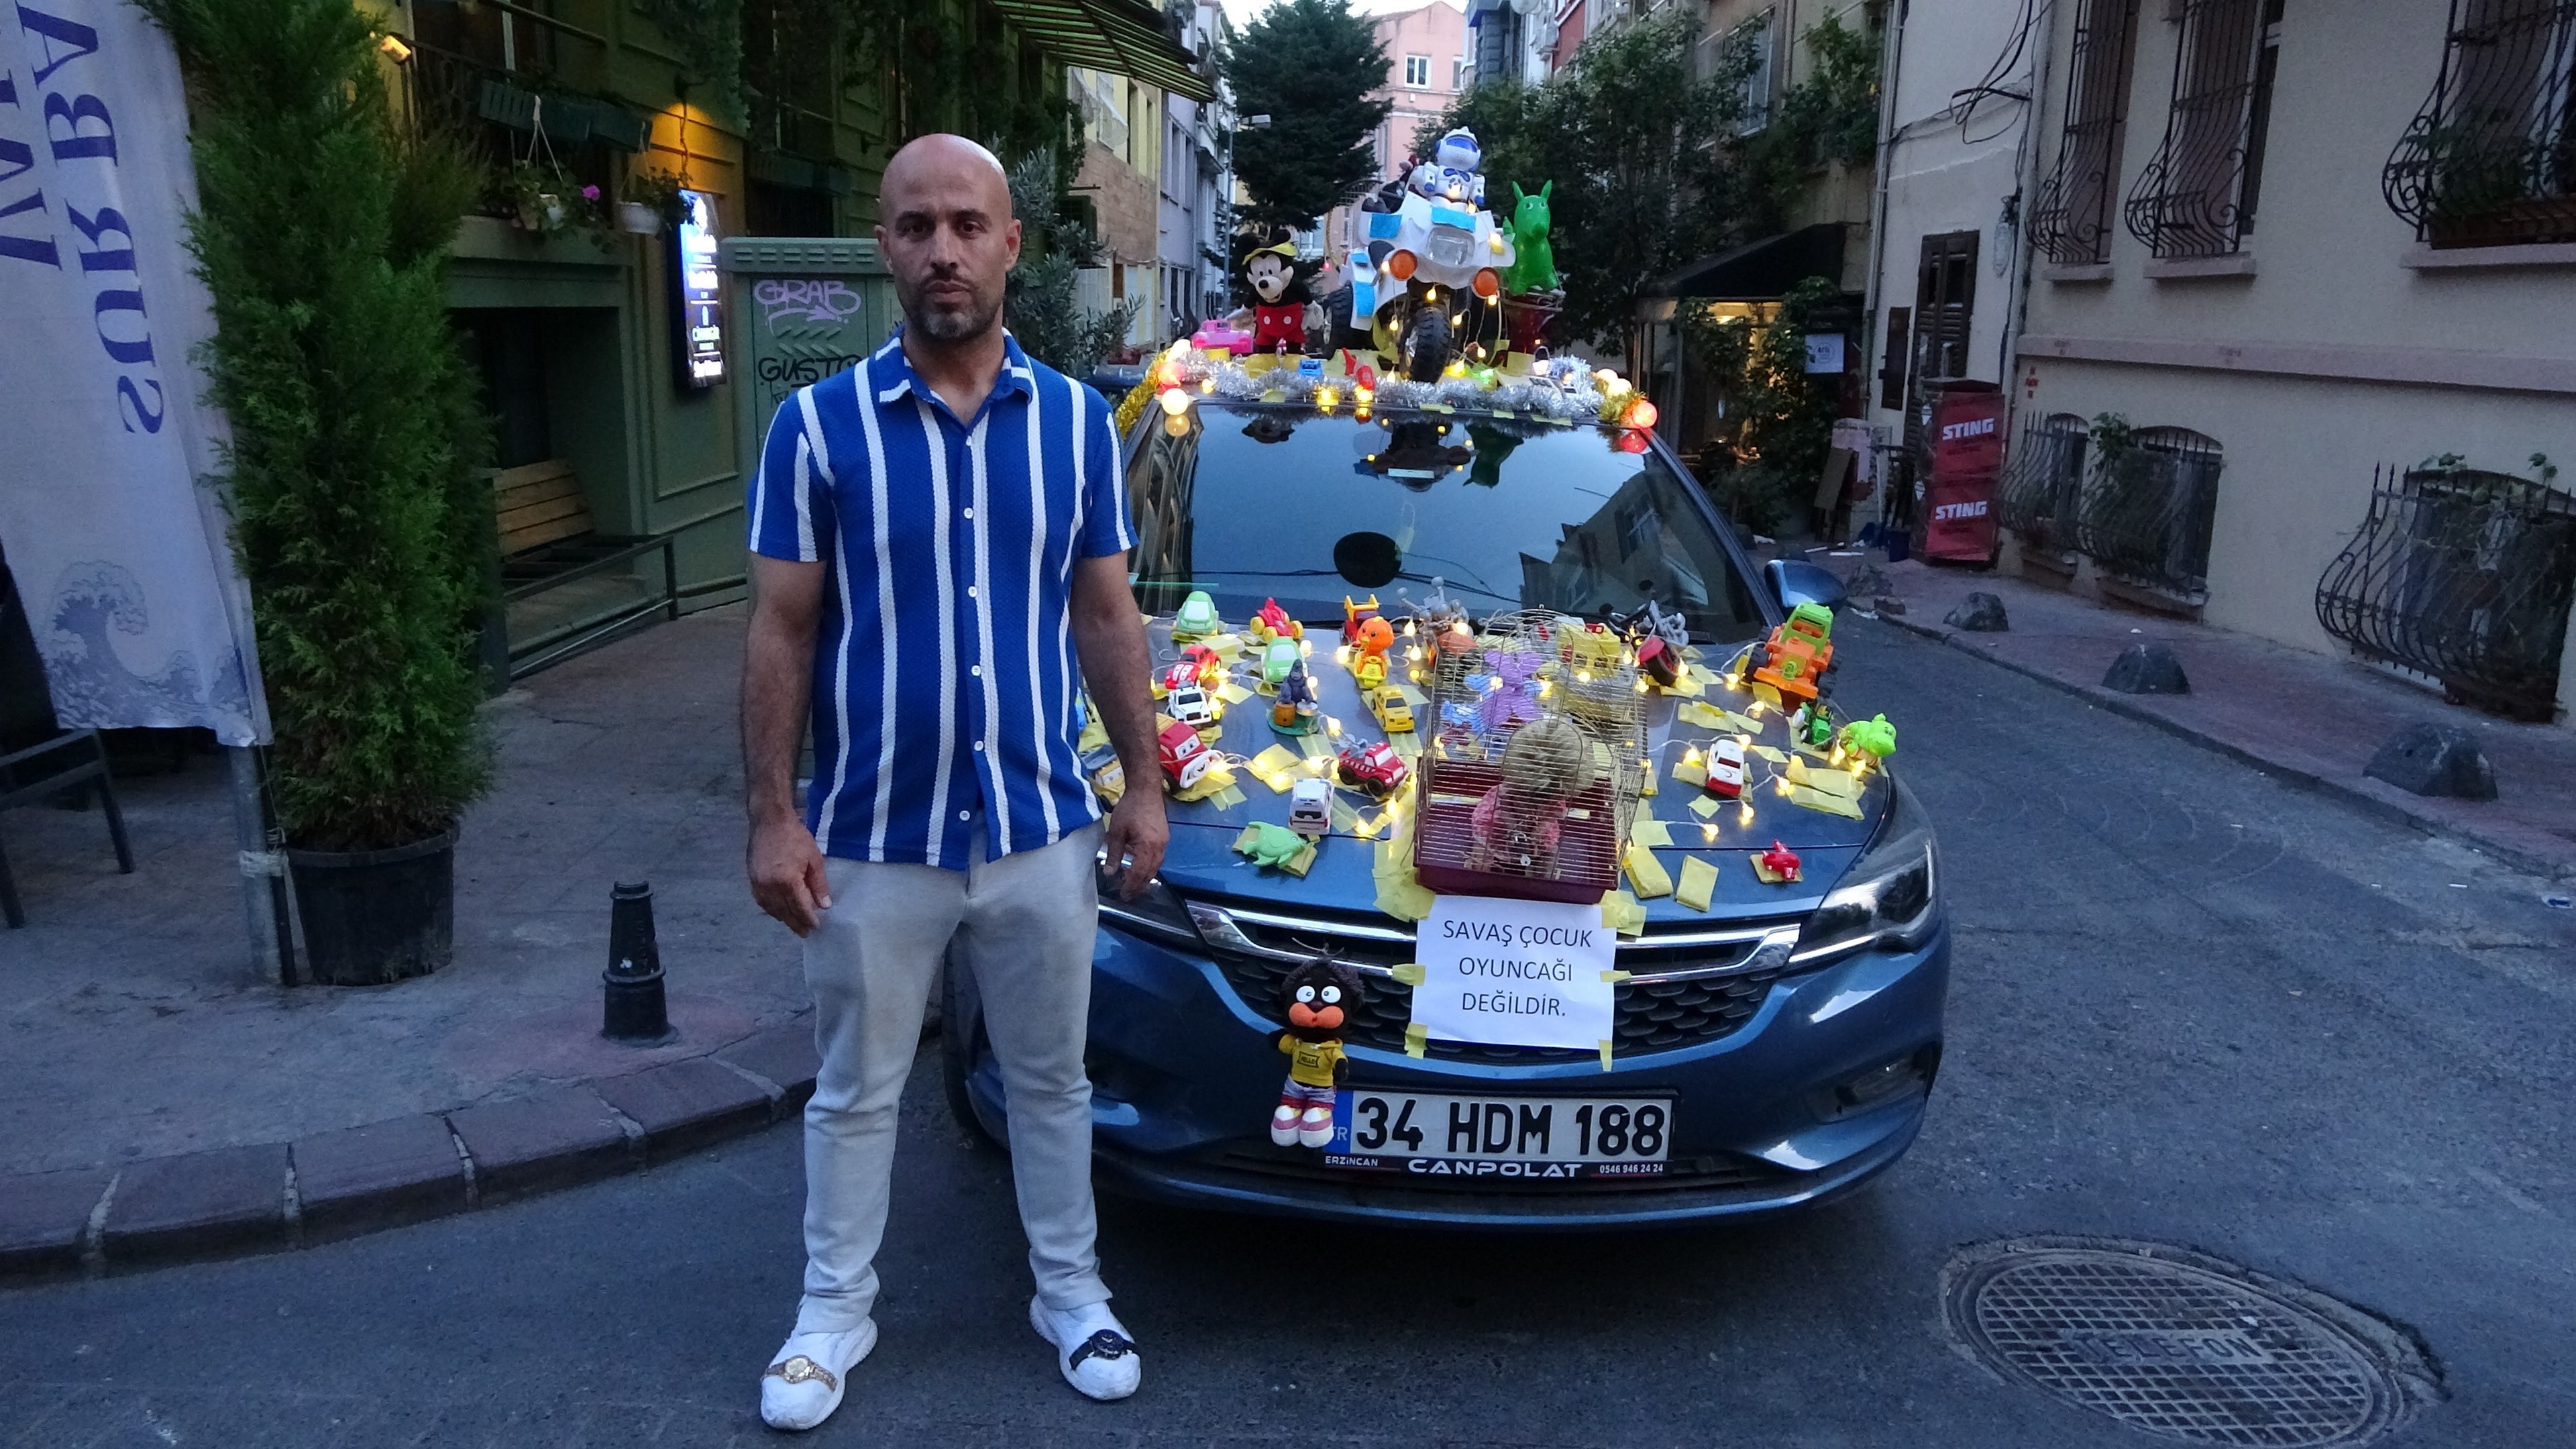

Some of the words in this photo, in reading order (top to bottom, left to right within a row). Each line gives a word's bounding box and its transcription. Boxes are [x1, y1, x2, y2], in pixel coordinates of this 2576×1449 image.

[754, 279, 861, 315] GRAB
[1942, 417, 1995, 441] STING
[1935, 500, 1988, 520] STING
[1443, 920, 1513, 947] SAVAŞ
[1519, 925, 1593, 948] ÇOCUK
[1459, 957, 1572, 981] OYUNCAĞI
[1462, 989, 1566, 1016] DEĞİLDİR.
[1356, 1097, 1424, 1152] 34
[1447, 1102, 1553, 1154] HDM
[1576, 1104, 1665, 1156] 188
[1408, 1159, 1582, 1177] CANPOLAT
[1599, 1165, 1621, 1173] 0546
[1623, 1164, 1638, 1173] 946
[1640, 1163, 1651, 1173] 24
[1653, 1163, 1663, 1173] 24
[2073, 1332, 2263, 1358] TELEFON
